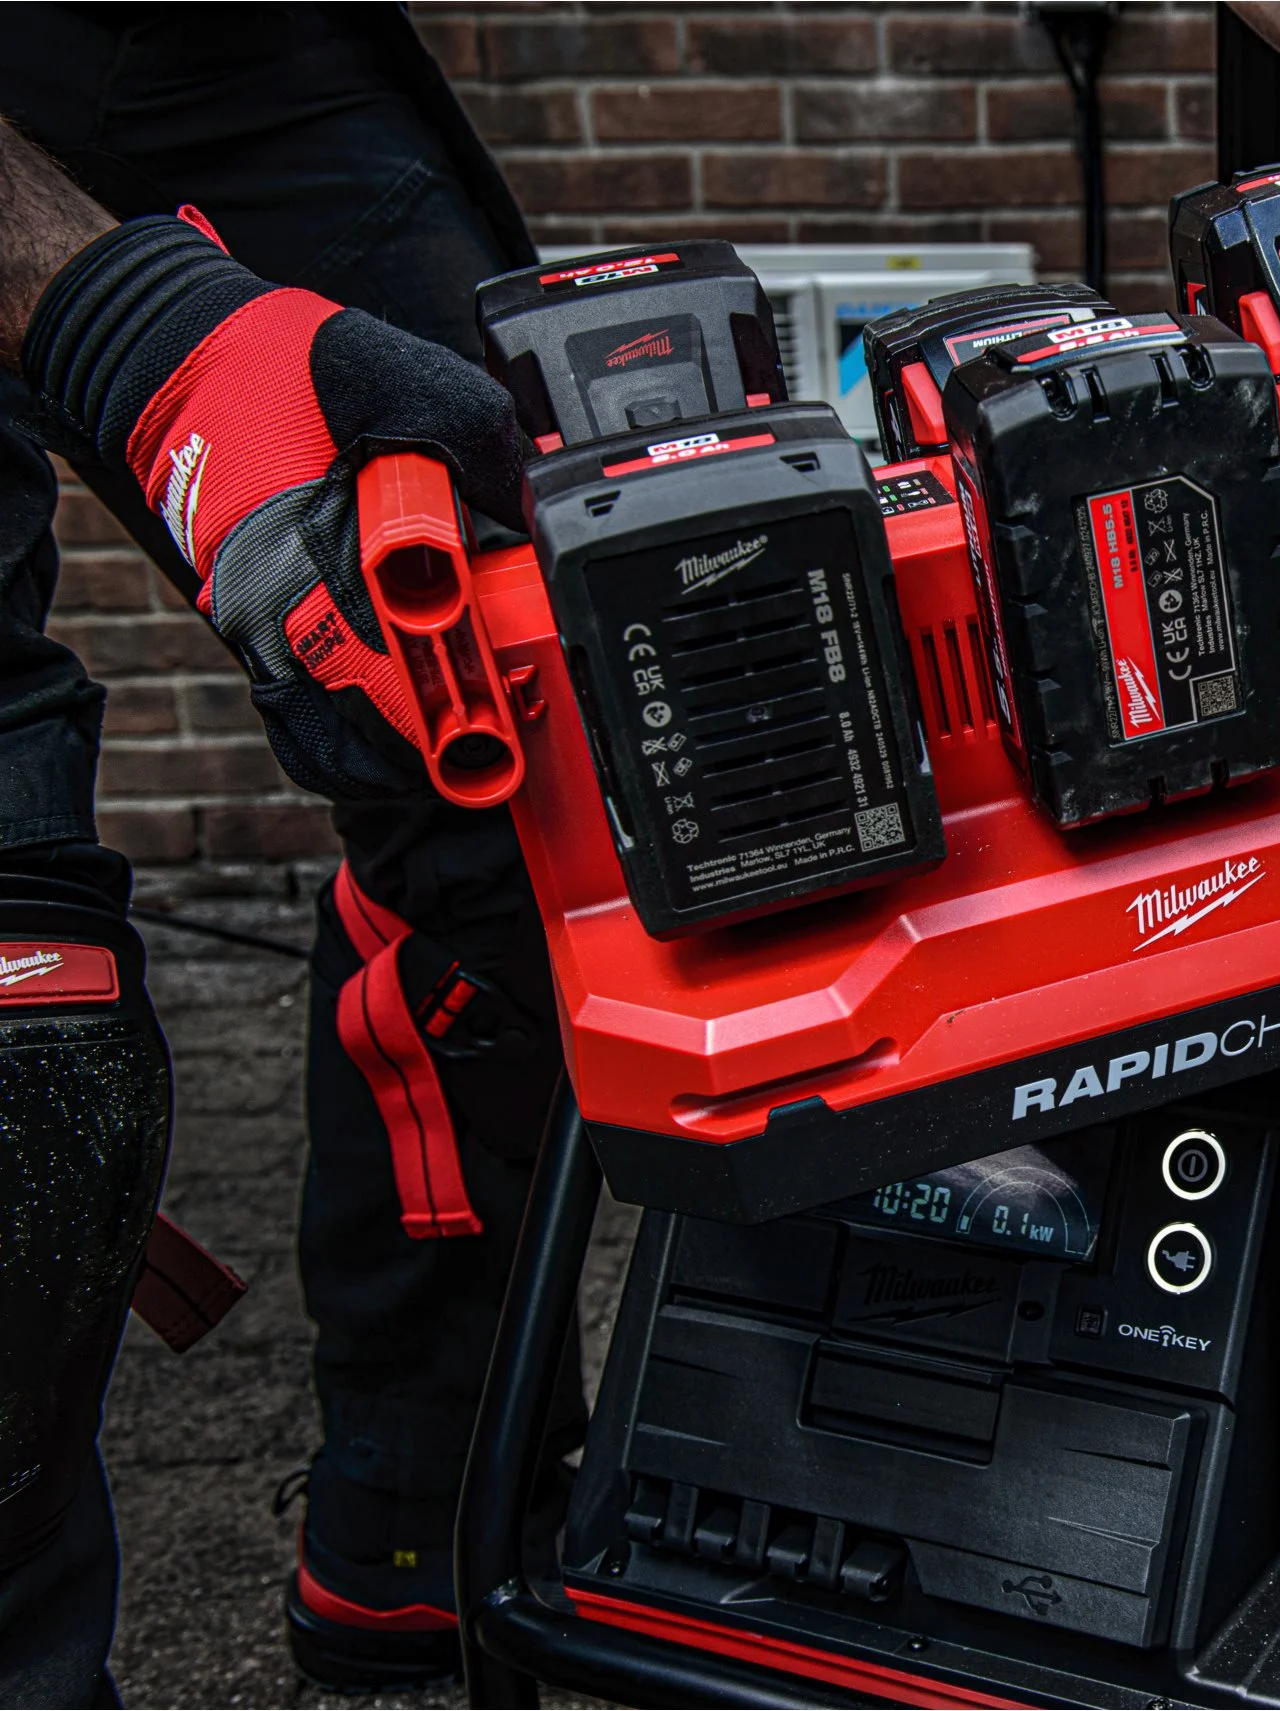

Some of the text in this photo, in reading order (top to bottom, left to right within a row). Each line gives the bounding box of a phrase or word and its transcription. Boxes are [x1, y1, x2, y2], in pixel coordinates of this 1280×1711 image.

[1054, 320, 1123, 340] M18
[606, 334, 674, 368] Milwaukee
[1199, 509, 1210, 534] P.R.C.
[1099, 501, 1125, 588] M18 HB5.5
[1192, 536, 1200, 549] UK
[1204, 543, 1213, 565] Made
[1196, 569, 1205, 583] SL7
[1163, 621, 1176, 646] UK
[1174, 617, 1188, 642] CA
[1204, 614, 1215, 653] Industries
[633, 668, 653, 696] CA
[645, 664, 665, 691] UK
[807, 568, 868, 807] M18 FB8 8.0 Ah 4932 4921 31
[1116, 658, 1153, 729] Milwaukee
[738, 847, 763, 860] 71364
[814, 824, 851, 843] Germany
[794, 853, 817, 866] Made
[819, 850, 827, 859] in
[828, 843, 855, 857] P.R.C.
[688, 863, 735, 883] Industries
[774, 848, 790, 859] SL7
[812, 839, 826, 849] UK
[1126, 856, 1262, 934] Milwaukee
[872, 1182, 952, 1224] 10:20
[856, 1261, 1001, 1306] Milwaukee
